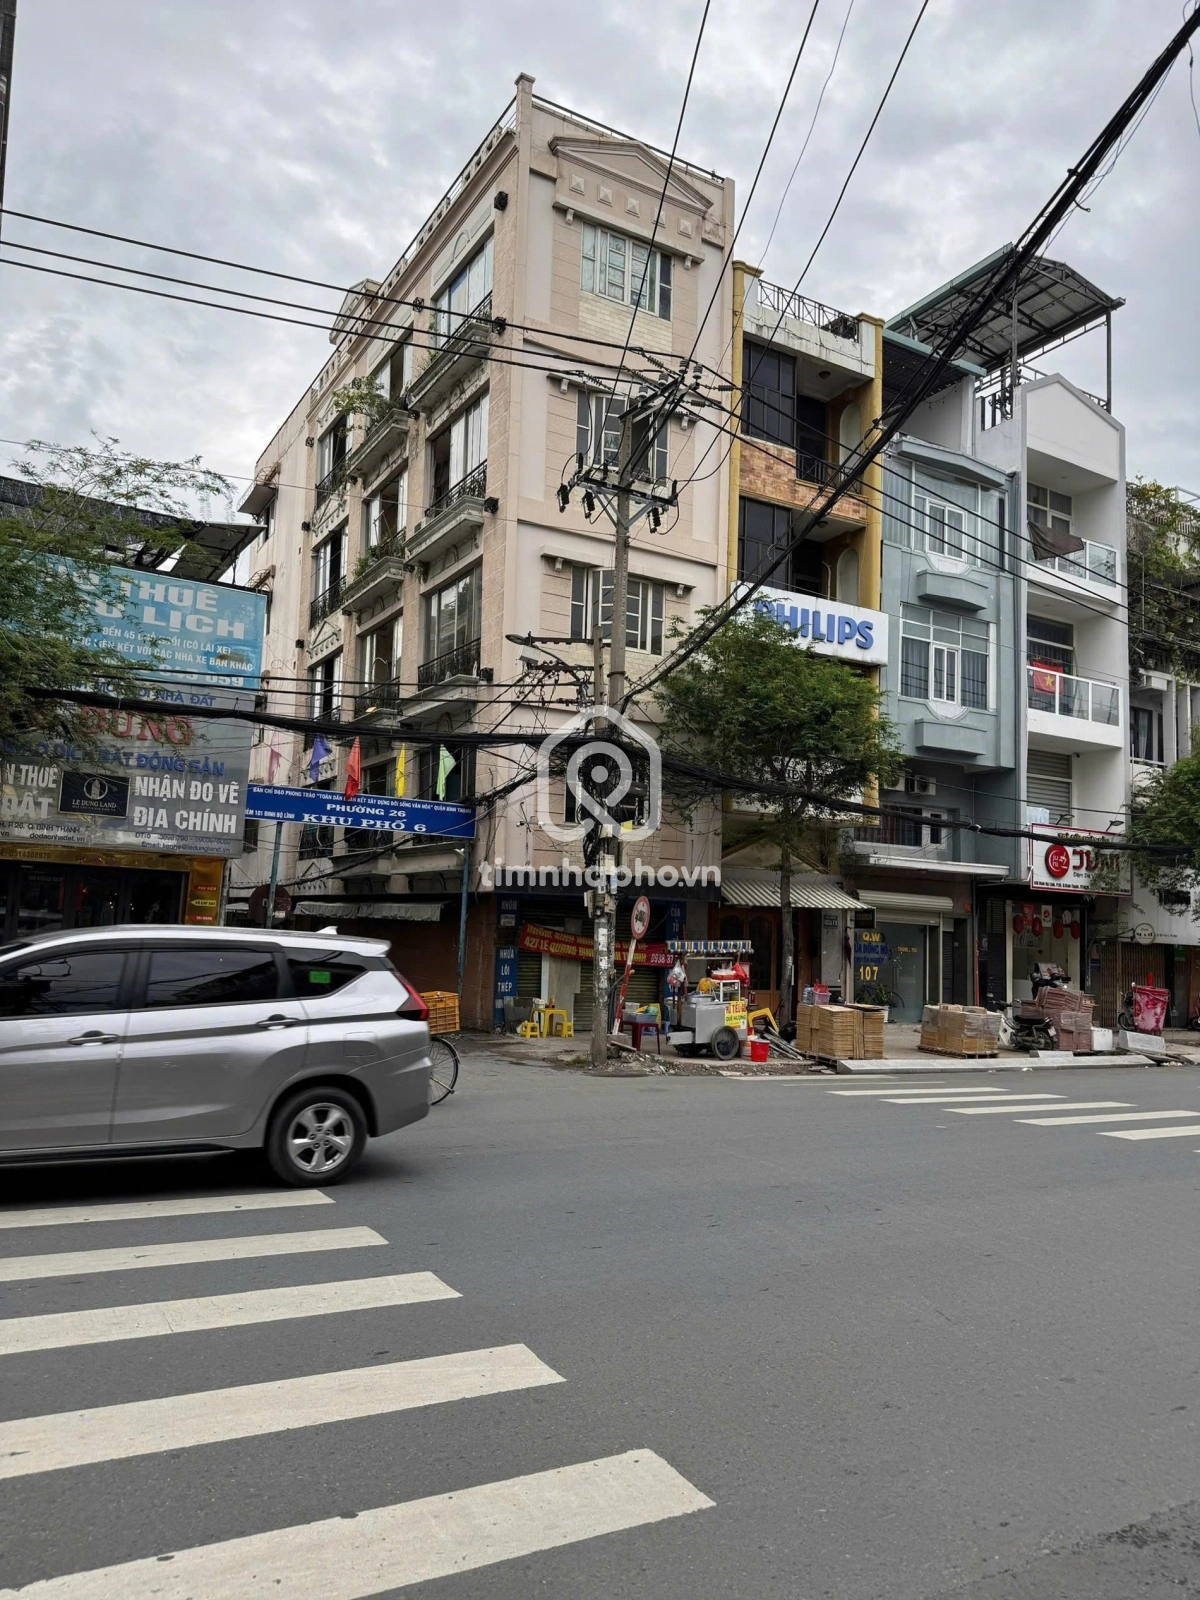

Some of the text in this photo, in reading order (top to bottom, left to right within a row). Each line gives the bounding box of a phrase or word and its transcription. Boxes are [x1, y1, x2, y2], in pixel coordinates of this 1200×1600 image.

[120, 577, 219, 613] THUÊ
[143, 605, 245, 640] LỊCH
[754, 600, 874, 650] PHILIPS
[124, 630, 135, 640] 45
[183, 638, 199, 650] (CÓ
[201, 642, 215, 653] LÁI
[174, 650, 193, 662] NHÀ
[196, 655, 207, 664] XE
[20, 764, 58, 788] THUÊ
[136, 751, 186, 773] ĐỘNG
[188, 756, 225, 777] SẢN
[135, 774, 239, 804] NHẬN ĐO VẼ
[99, 801, 117, 809] LAND
[326, 803, 406, 818] PHƯỜNG 26
[133, 806, 237, 834] ĐỊA CHÍNH
[302, 813, 427, 832] KHU PHỐ 6
[860, 965, 879, 981] 107
